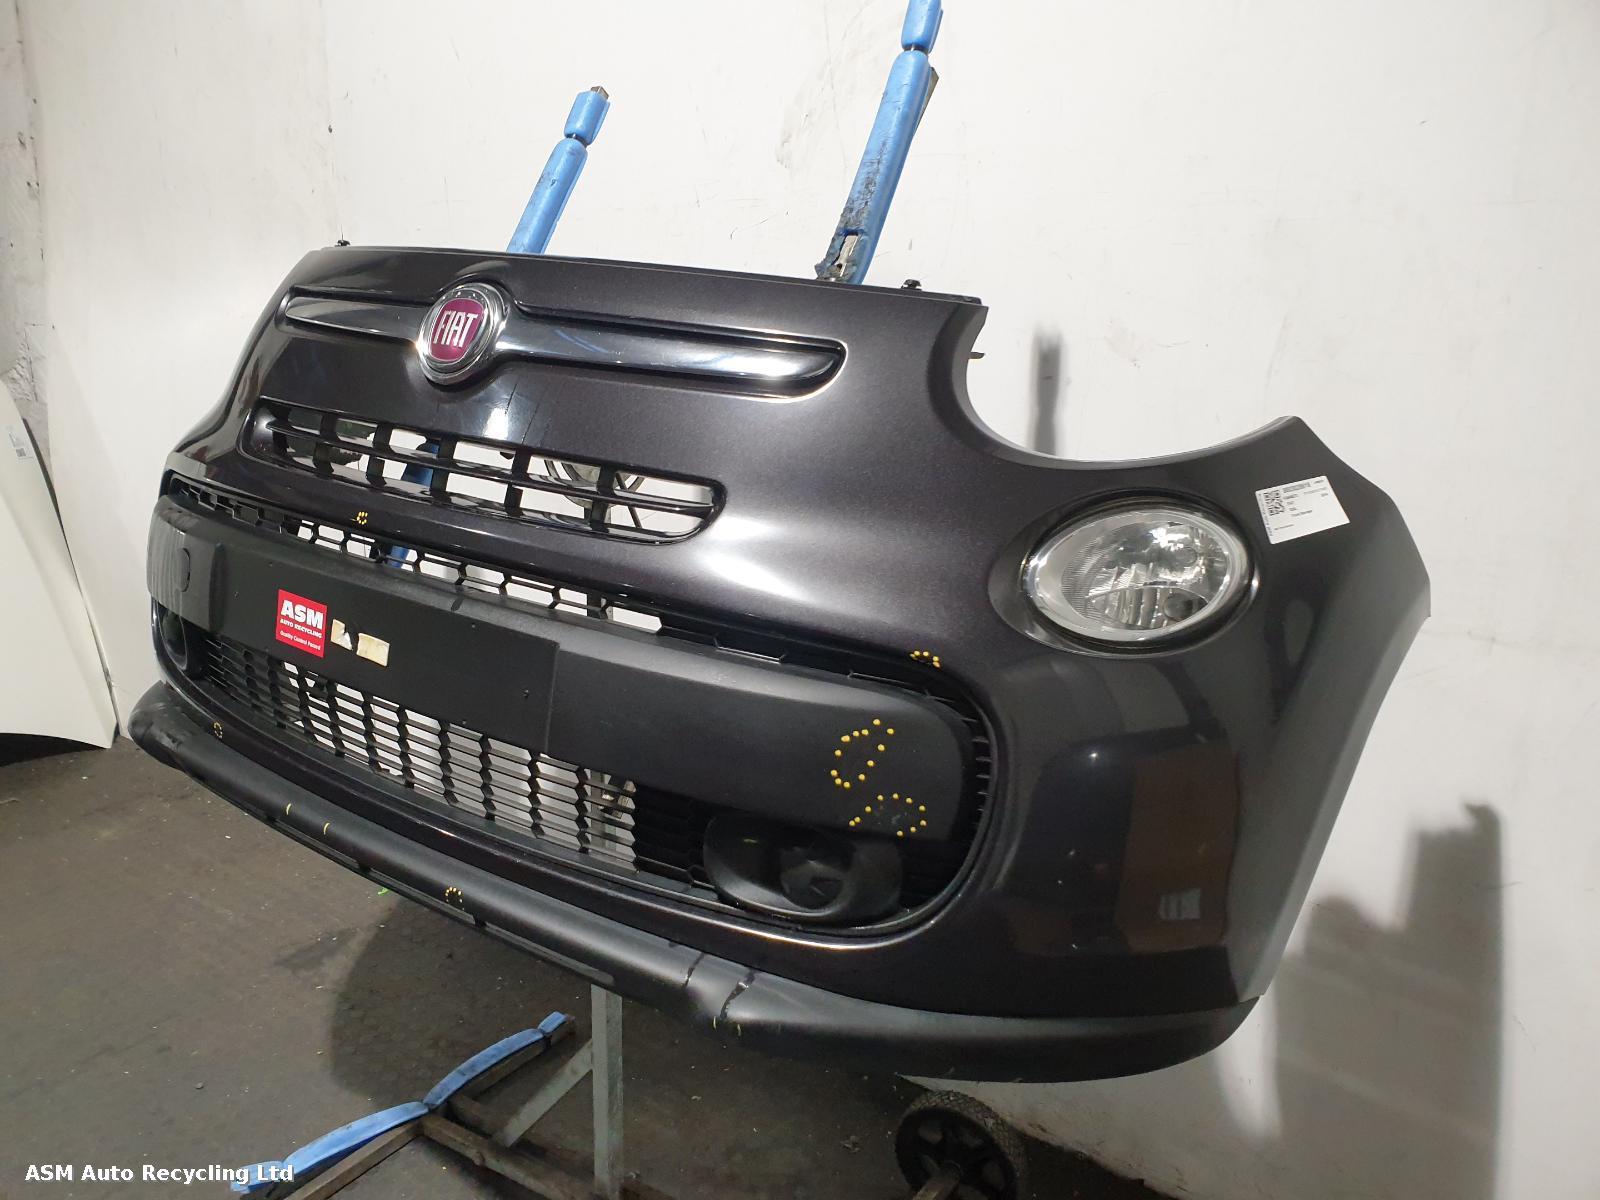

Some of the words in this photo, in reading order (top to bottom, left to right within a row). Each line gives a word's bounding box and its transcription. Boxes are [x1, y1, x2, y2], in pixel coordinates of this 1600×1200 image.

[433, 310, 479, 348] FIAT
[281, 600, 323, 629] ASM
[280, 618, 294, 628] AUTO
[294, 623, 322, 638] RECYCLING
[280, 630, 293, 640] Quality
